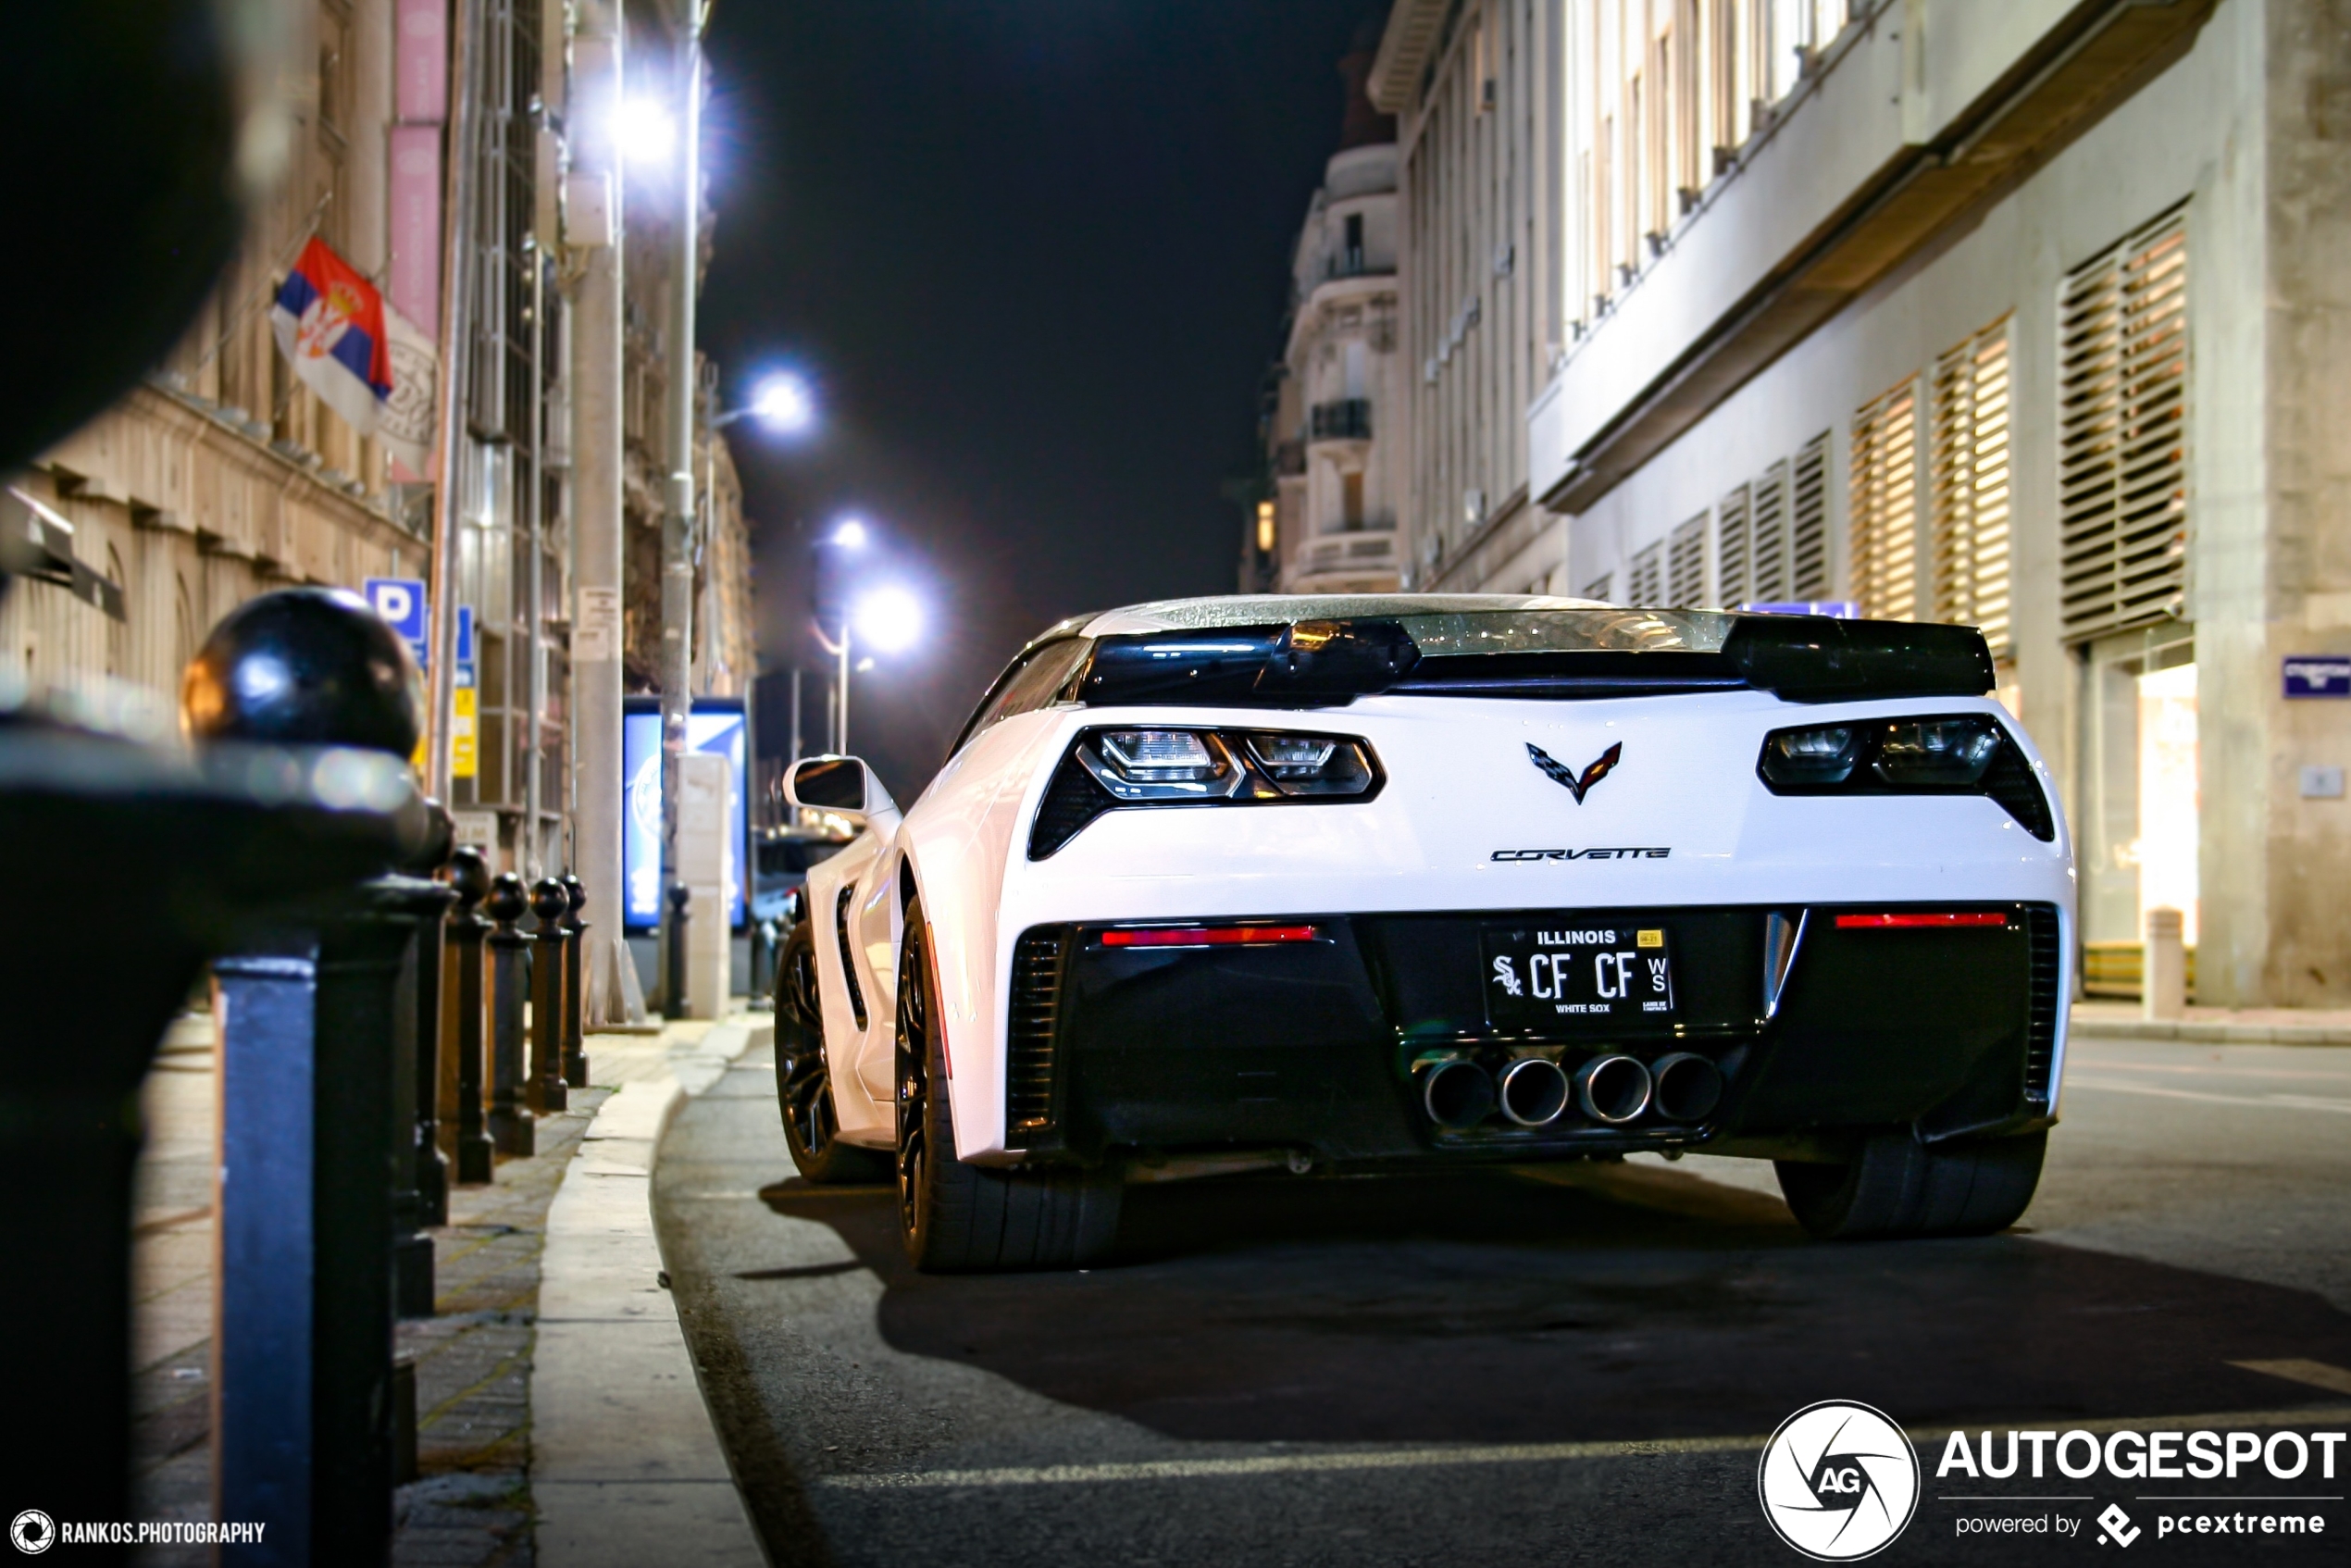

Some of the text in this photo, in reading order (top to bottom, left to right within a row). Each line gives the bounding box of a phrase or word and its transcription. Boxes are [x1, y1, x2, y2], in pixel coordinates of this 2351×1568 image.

[1490, 847, 1672, 862] CORVETTE
[1536, 929, 1616, 945] ILLINOIS
[1529, 952, 1636, 1000] CF CF
[1556, 1003, 1611, 1014] WHITE SOX
